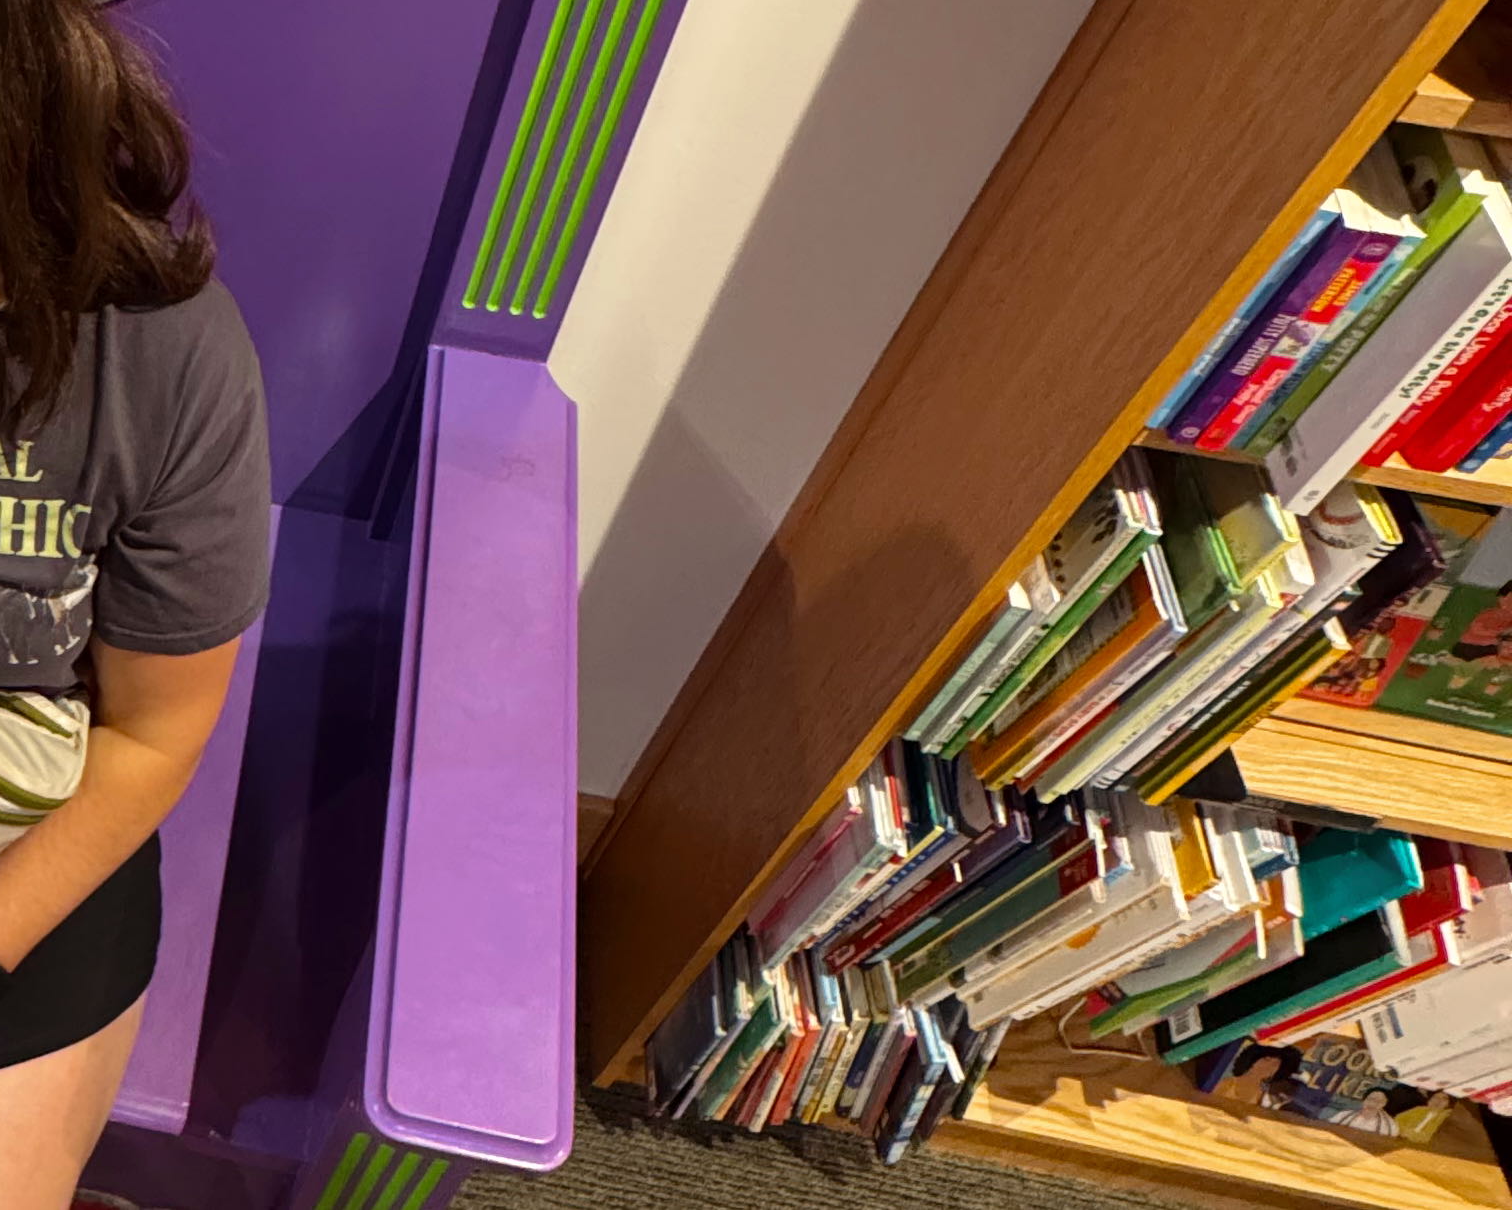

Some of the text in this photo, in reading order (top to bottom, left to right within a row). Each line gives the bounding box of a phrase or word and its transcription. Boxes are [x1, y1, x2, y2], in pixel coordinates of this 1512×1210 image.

[1261, 313, 1296, 341] POTTY
[1467, 309, 1490, 324] Go
[1454, 325, 1475, 339] to
[1434, 340, 1461, 361] the
[1453, 336, 1493, 367] Upon
[1398, 362, 1441, 400] Potty!
[1443, 366, 1459, 376] a
[1413, 379, 1453, 407] Potty
